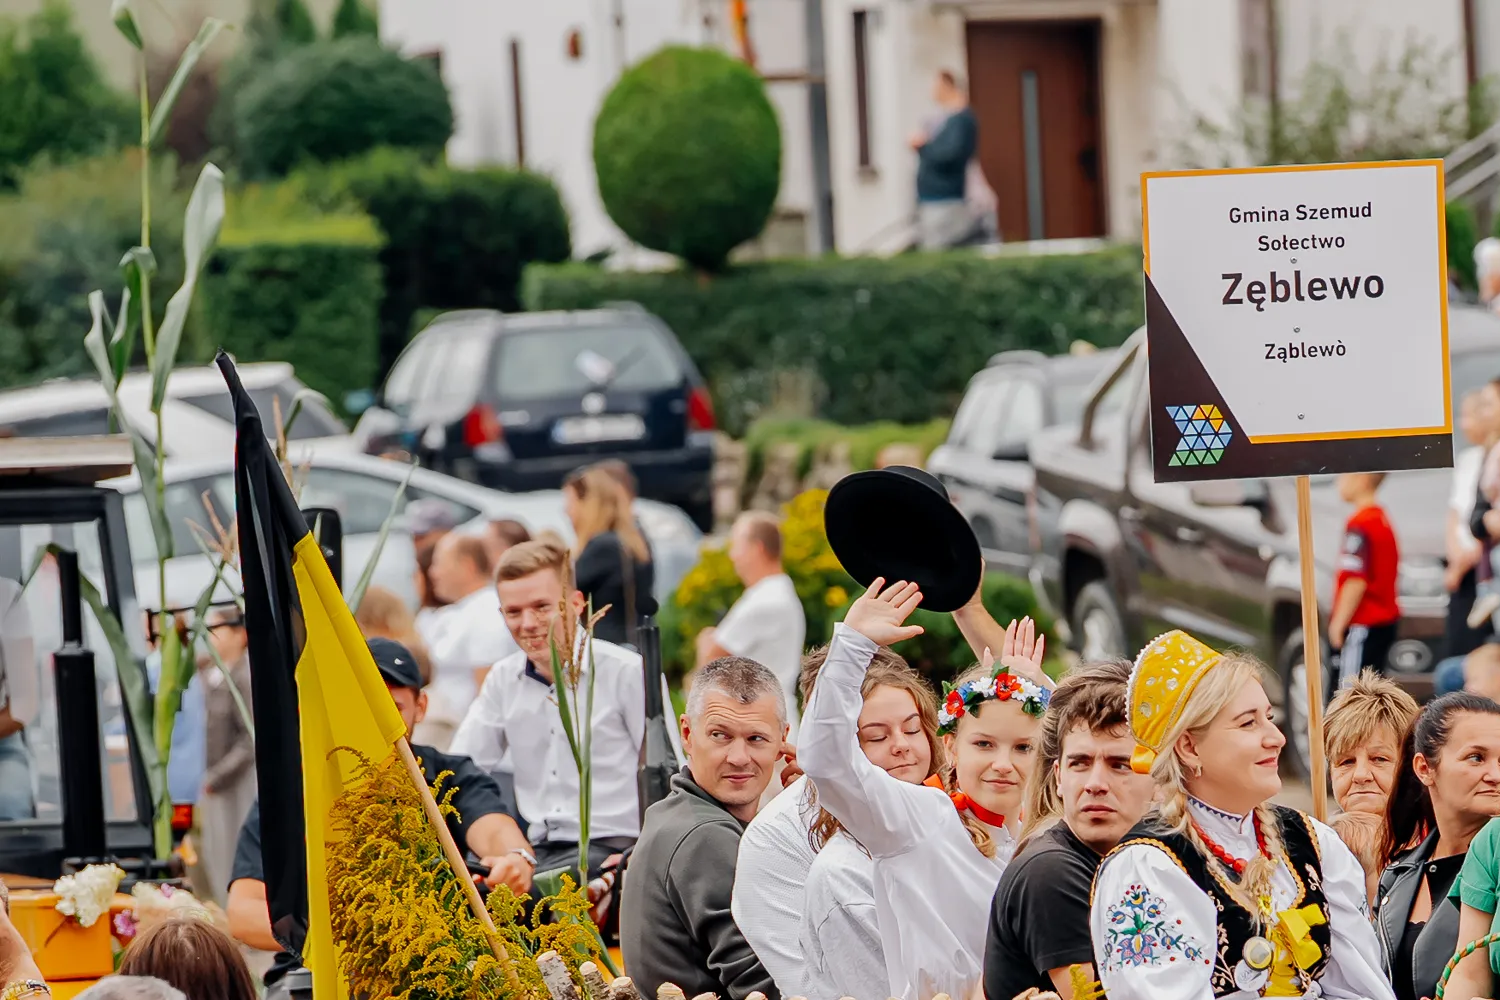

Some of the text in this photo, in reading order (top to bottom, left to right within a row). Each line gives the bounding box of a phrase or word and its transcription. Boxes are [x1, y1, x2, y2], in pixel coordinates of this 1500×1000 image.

[1229, 201, 1373, 224] Gmina Szemud
[1257, 234, 1346, 252] Sołectwo
[1221, 270, 1385, 312] Zęblewo
[1264, 339, 1347, 364] Ząblewò
